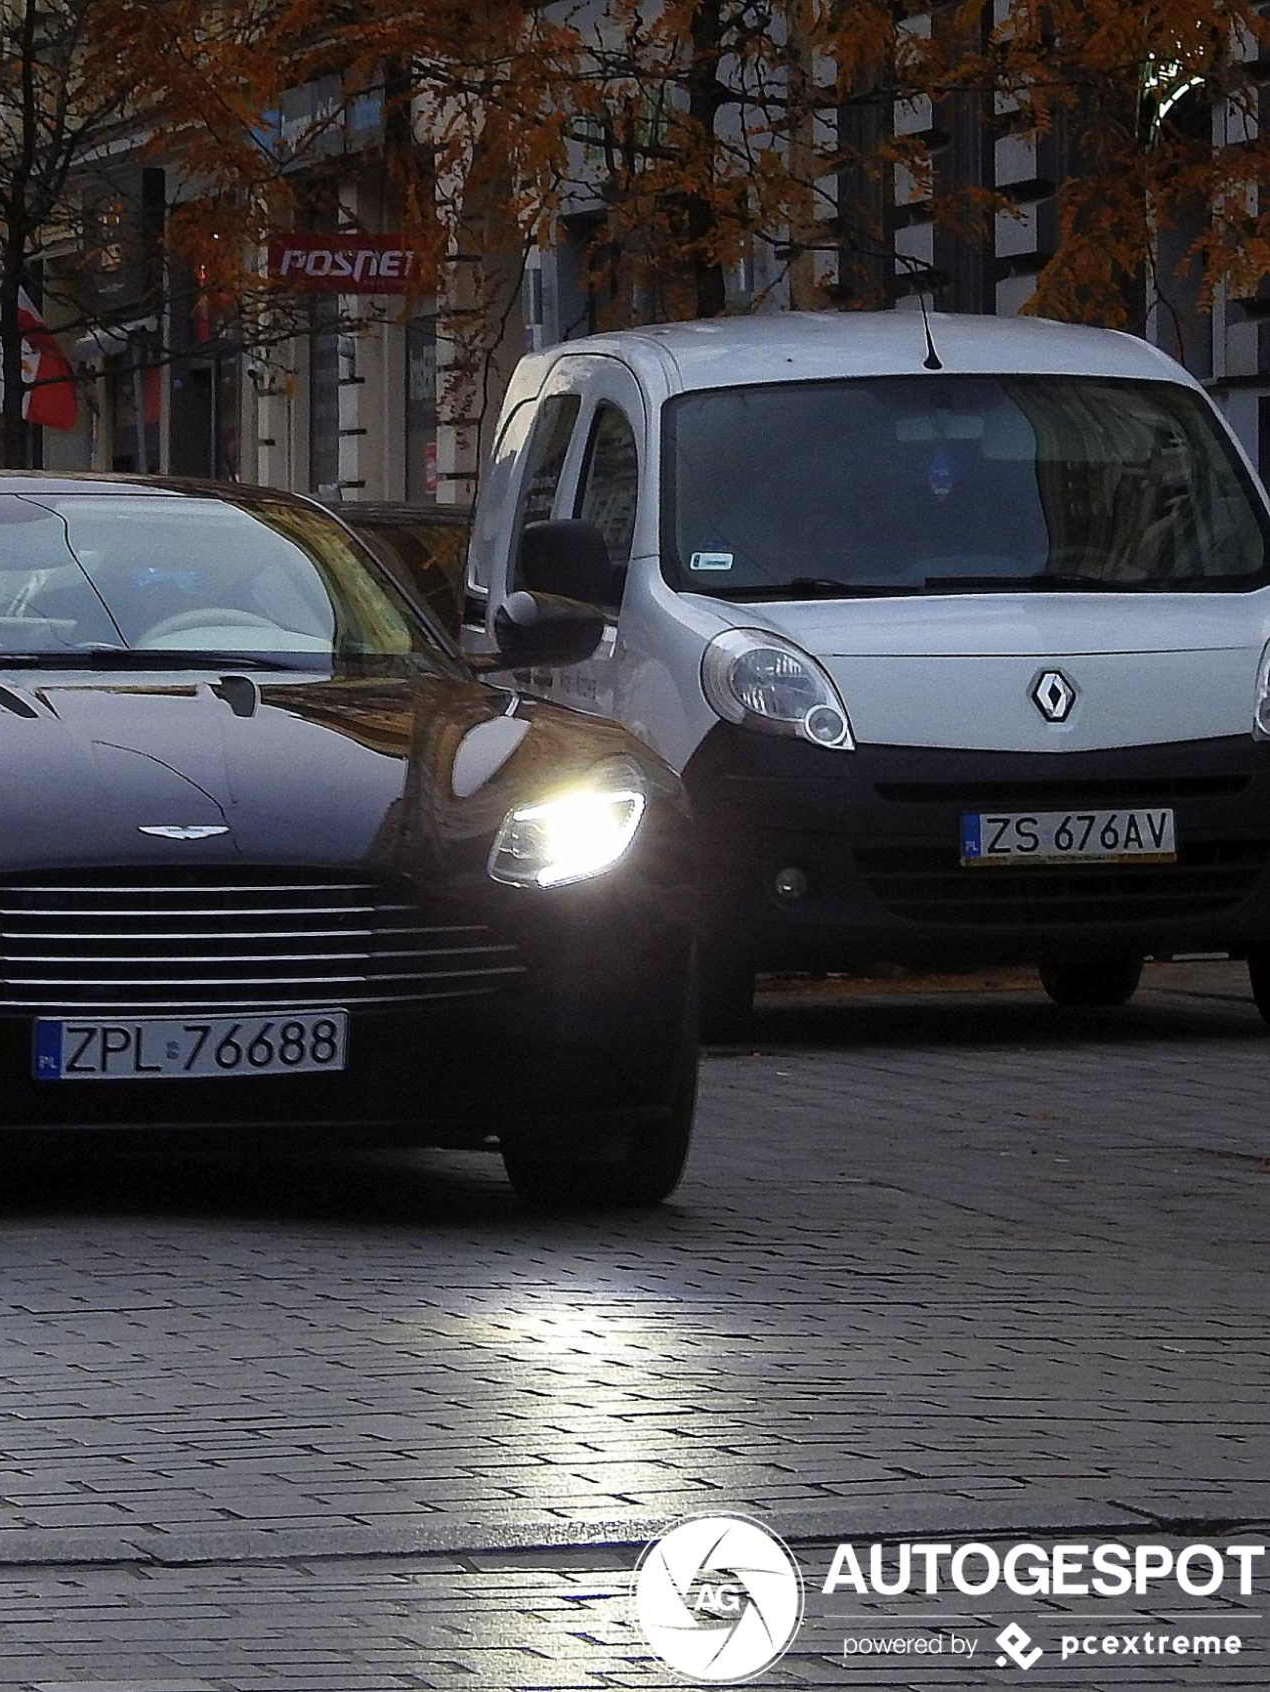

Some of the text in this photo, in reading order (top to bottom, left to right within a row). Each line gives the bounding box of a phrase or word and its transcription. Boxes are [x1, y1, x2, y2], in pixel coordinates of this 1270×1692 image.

[280, 249, 414, 283] POSNET
[986, 812, 1167, 854] ZS 676AV
[38, 1055, 58, 1070] PL
[65, 1018, 338, 1073] ZPL 76688
